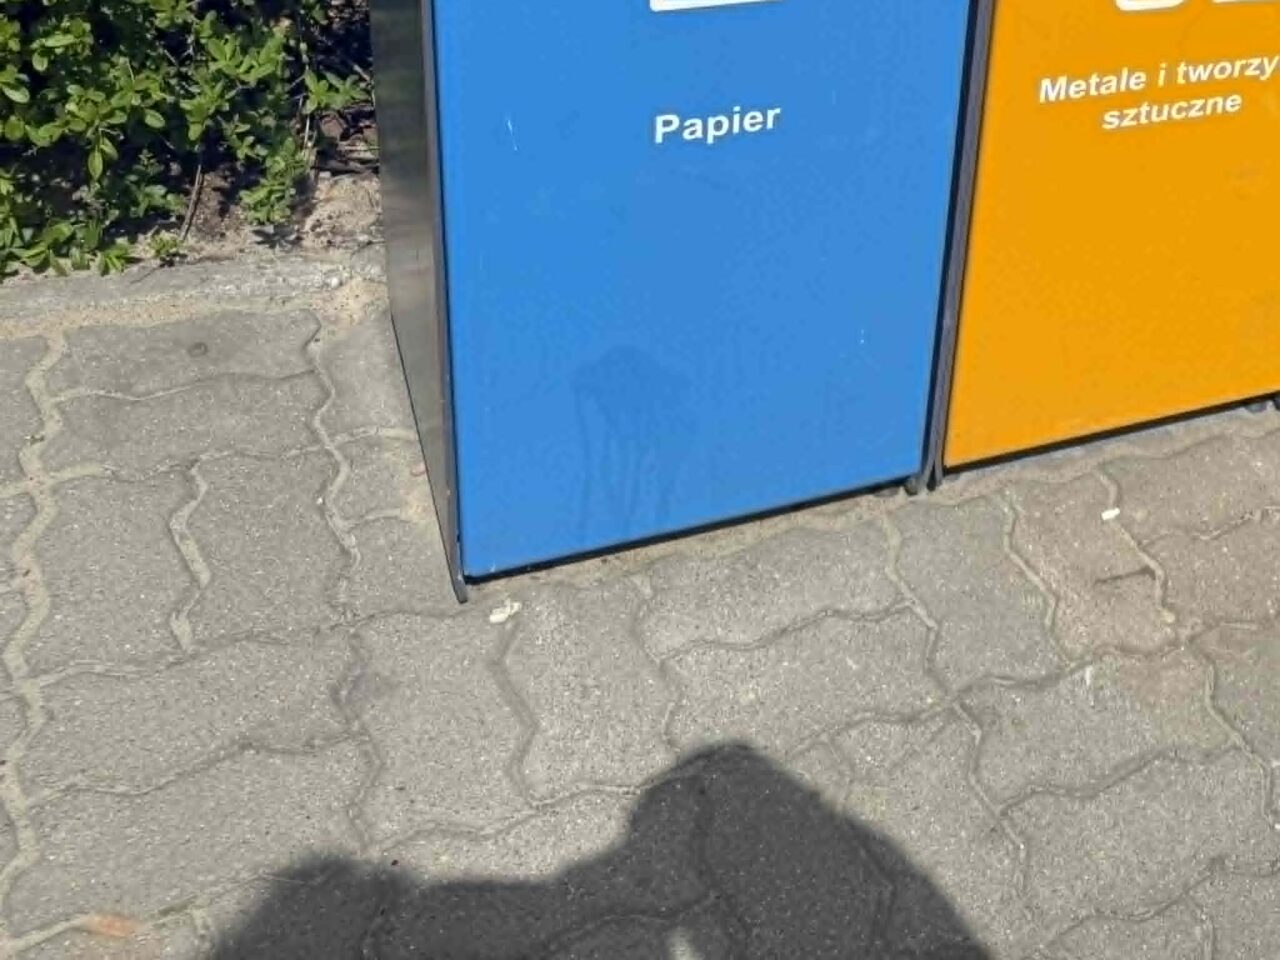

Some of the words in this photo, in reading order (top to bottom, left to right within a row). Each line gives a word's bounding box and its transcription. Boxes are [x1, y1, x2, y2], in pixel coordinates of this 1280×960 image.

[1039, 74, 1147, 102] Metale
[1158, 68, 1167, 93] i
[655, 106, 782, 145] Papier
[1103, 94, 1242, 129] sztuczne
